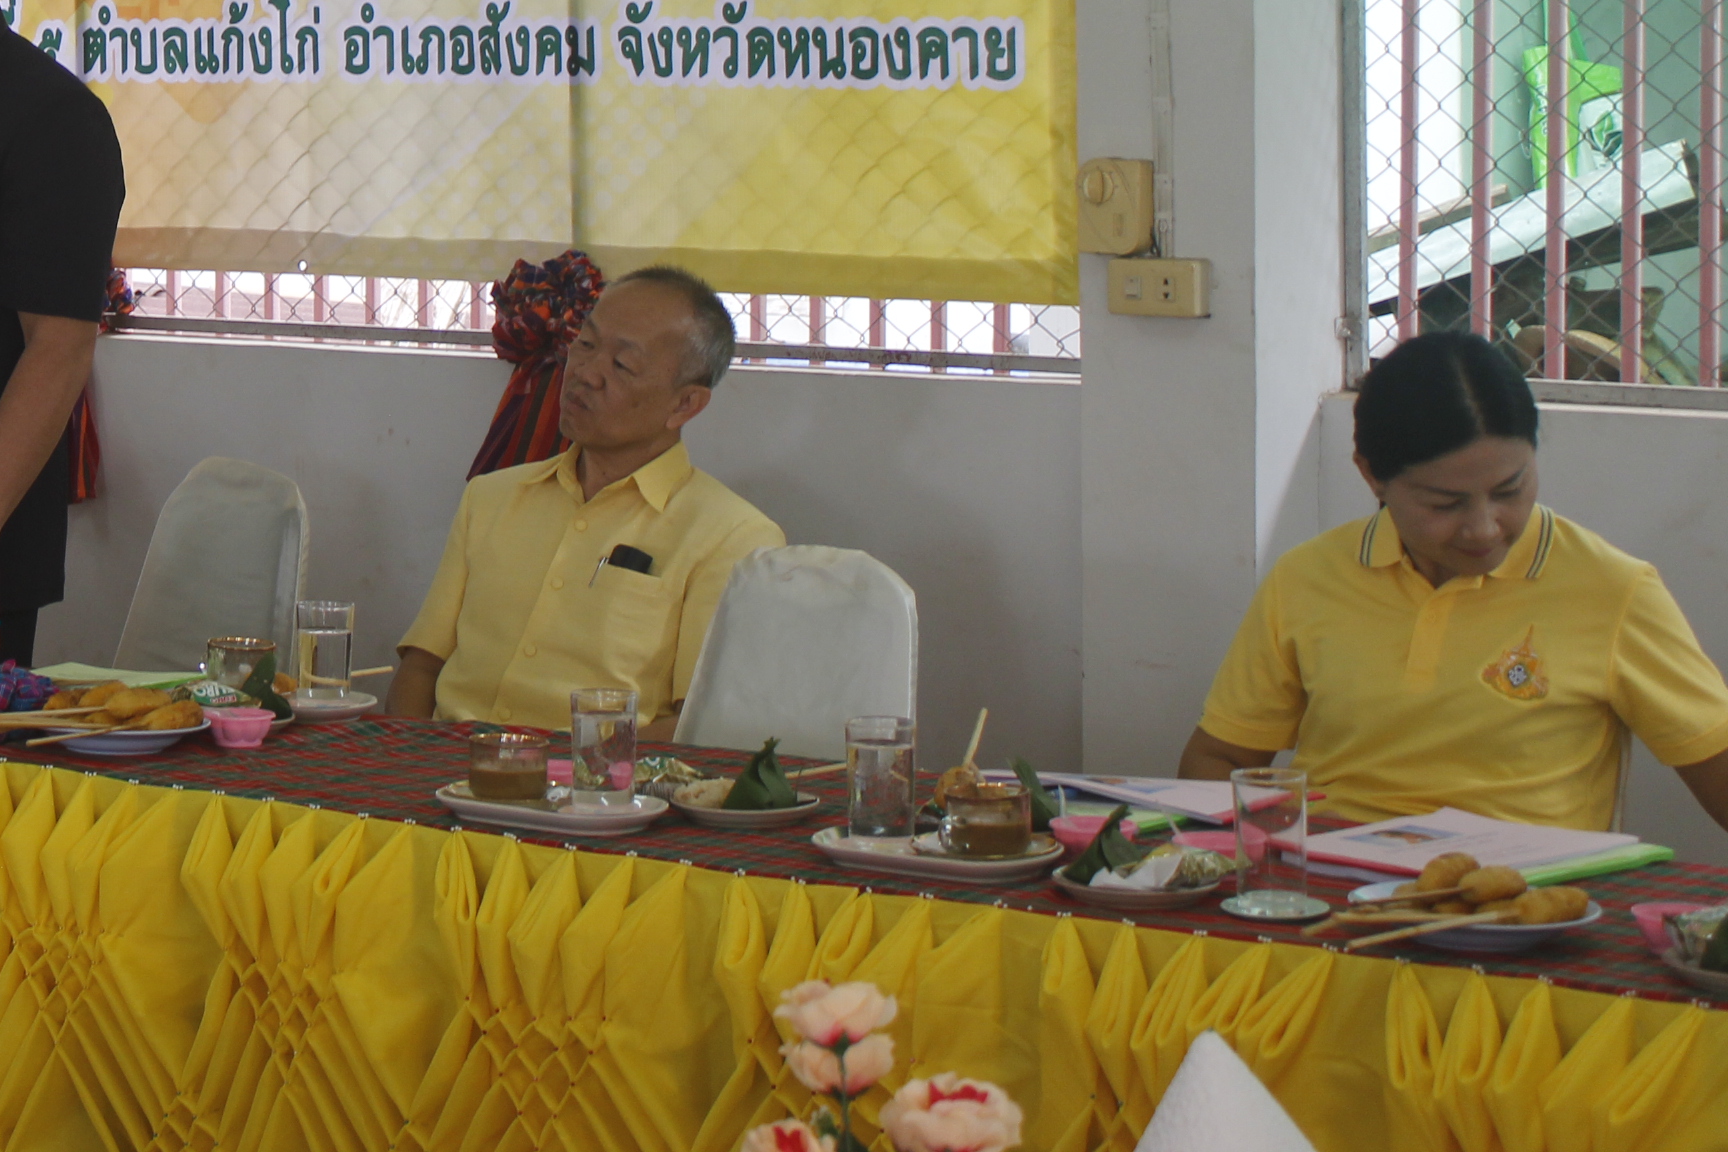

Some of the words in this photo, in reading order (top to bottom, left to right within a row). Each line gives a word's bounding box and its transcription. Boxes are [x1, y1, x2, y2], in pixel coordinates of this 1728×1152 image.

[345, 0, 596, 77] อำเภอสังคม
[618, 0, 1017, 82] จังหวัดหนองคาย
